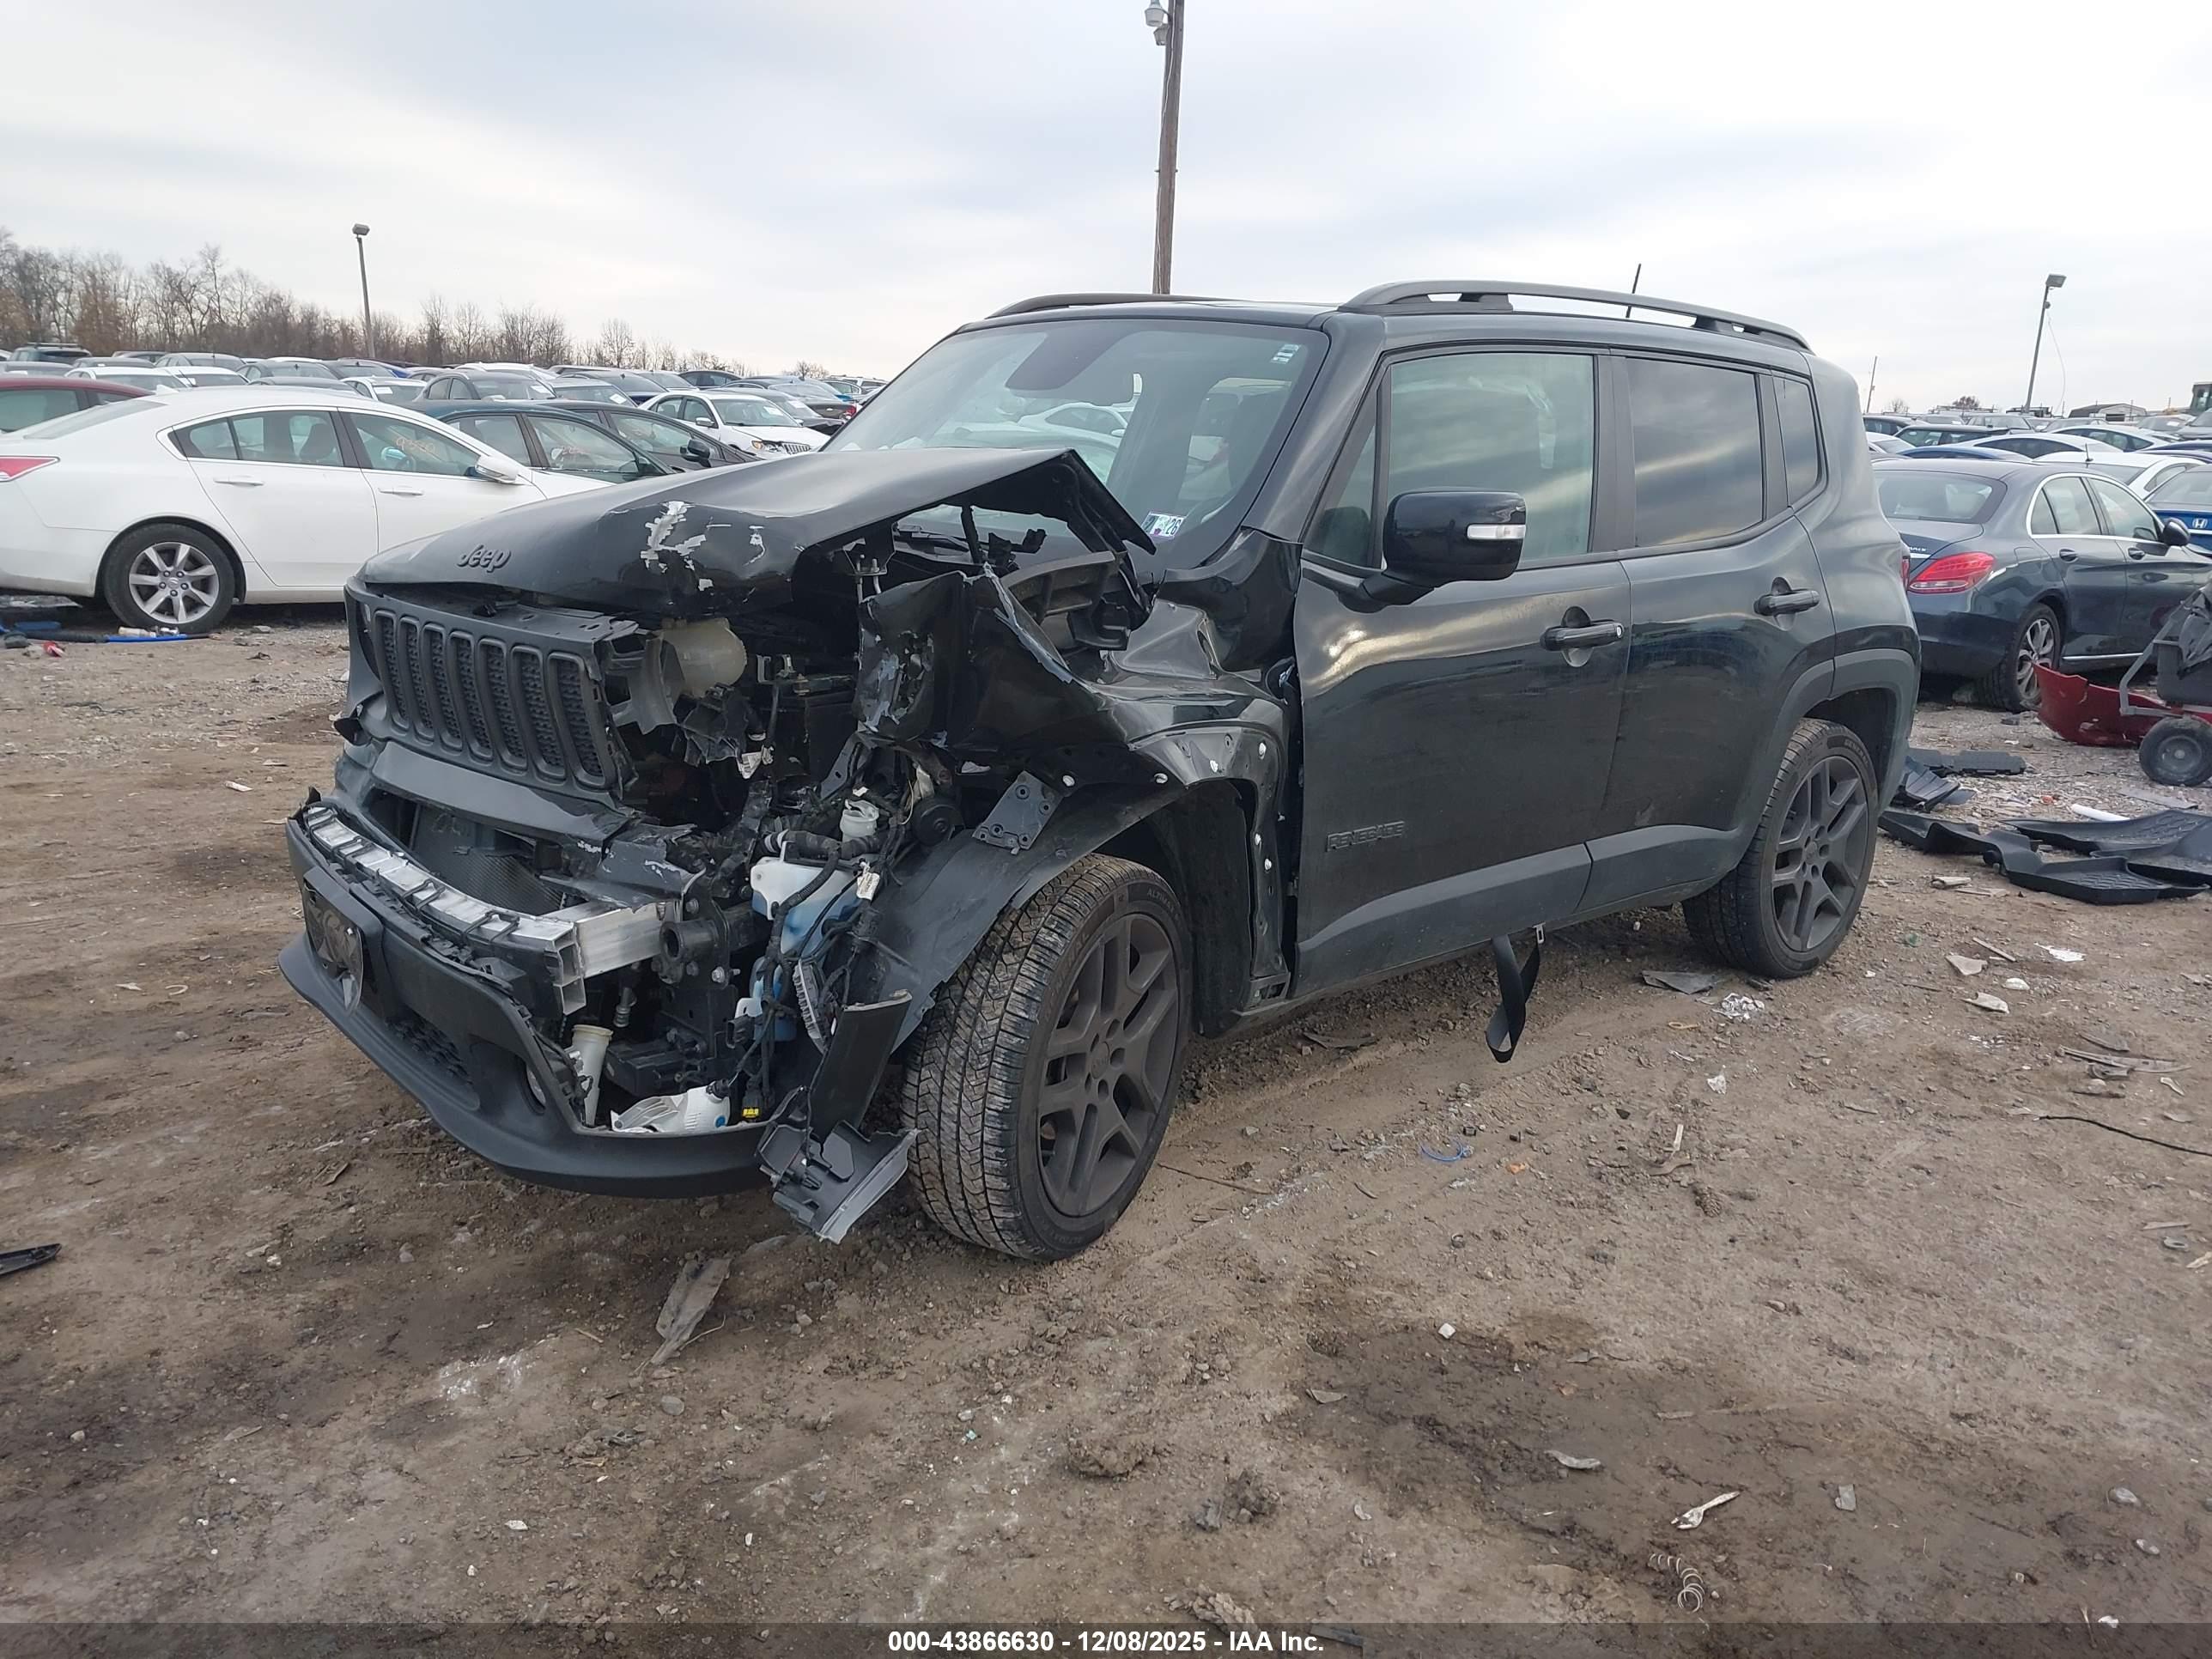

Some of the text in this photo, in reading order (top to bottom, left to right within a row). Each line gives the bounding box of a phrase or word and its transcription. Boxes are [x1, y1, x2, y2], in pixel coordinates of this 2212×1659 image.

[1165, 518, 1182, 535] 26
[457, 543, 512, 574] Jeep
[1326, 820, 1406, 852] RENEGADE
